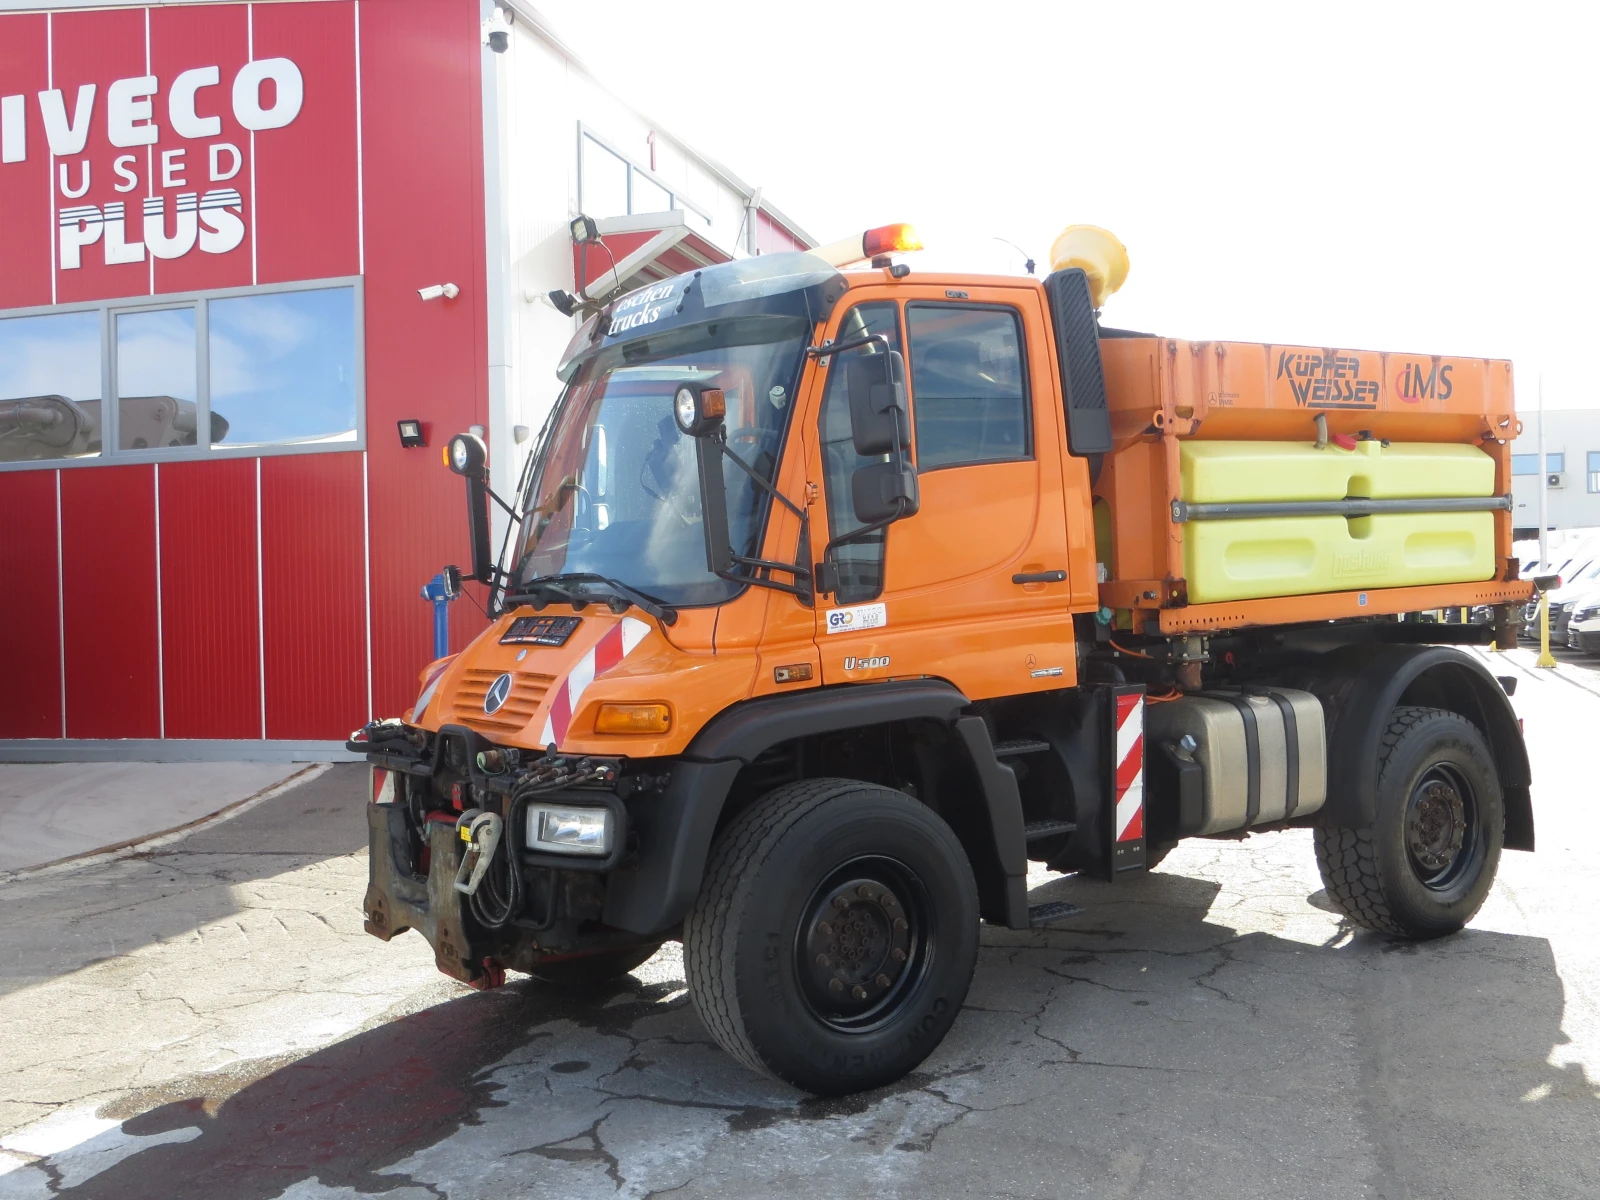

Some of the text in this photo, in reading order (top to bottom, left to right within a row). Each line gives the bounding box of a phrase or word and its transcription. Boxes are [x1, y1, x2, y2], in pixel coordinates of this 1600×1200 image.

[1, 57, 304, 164] IVECO
[59, 143, 243, 199] USED
[59, 187, 246, 270] PLUS
[608, 302, 662, 336] trucks
